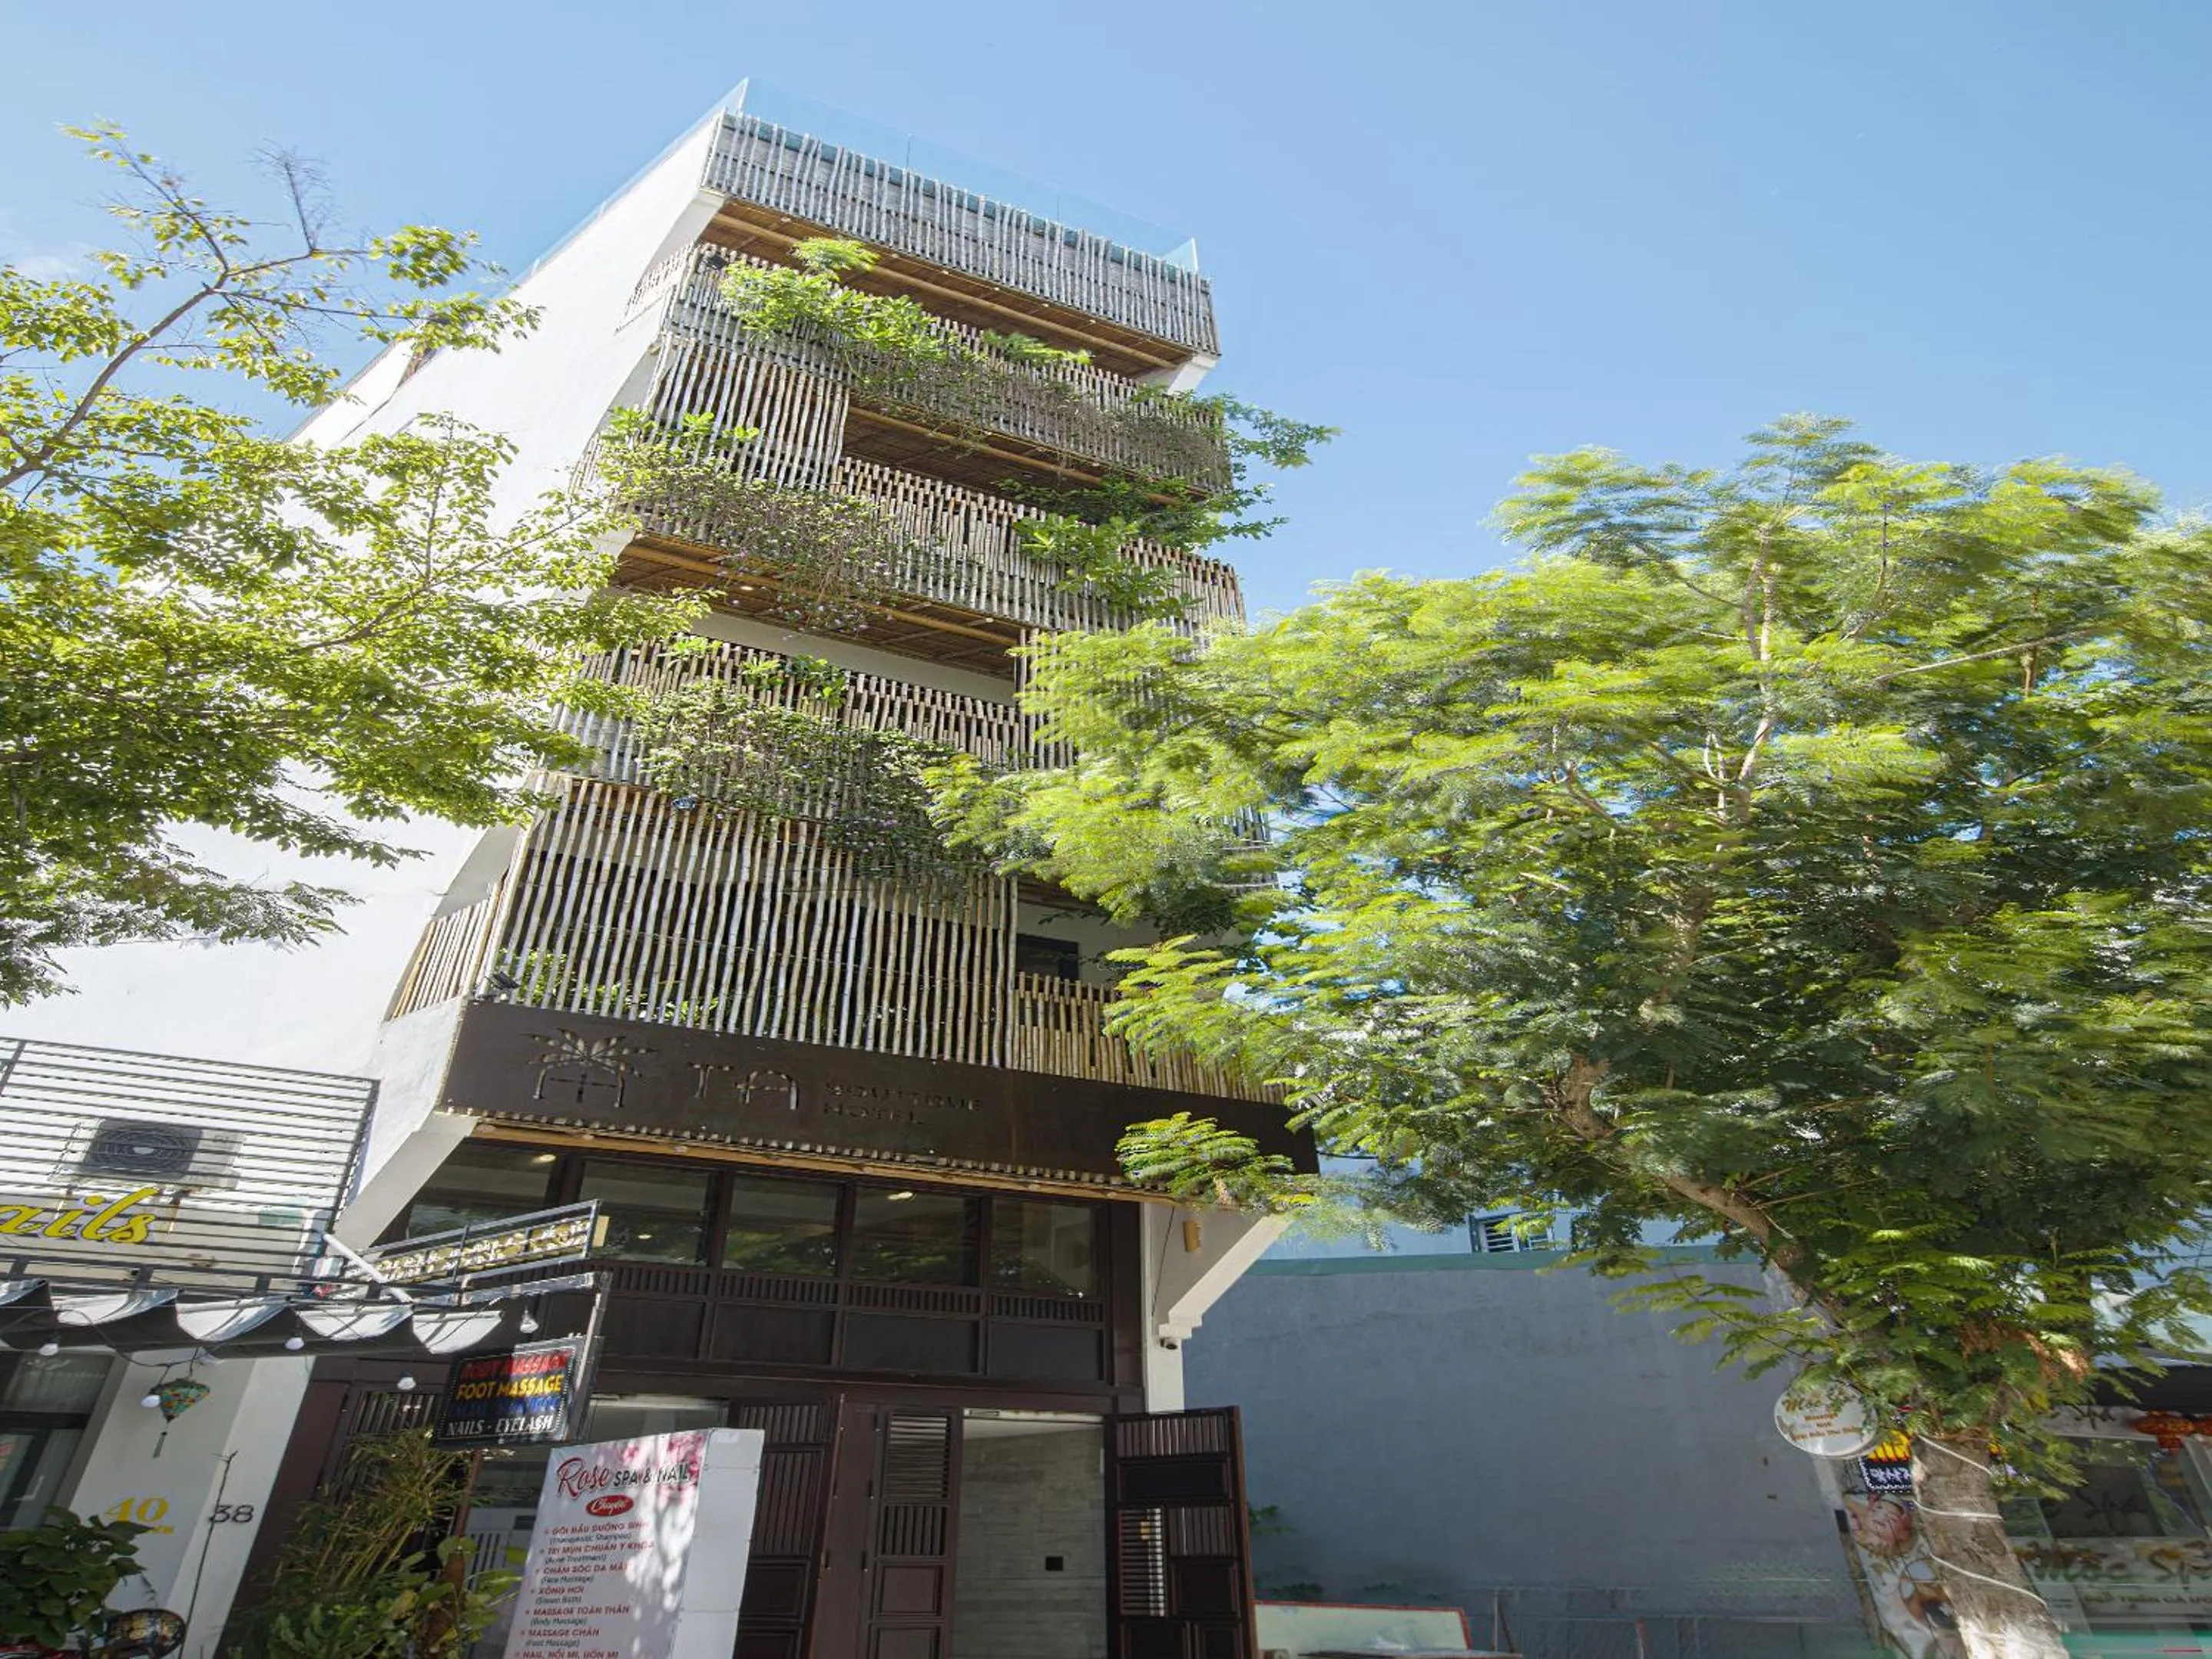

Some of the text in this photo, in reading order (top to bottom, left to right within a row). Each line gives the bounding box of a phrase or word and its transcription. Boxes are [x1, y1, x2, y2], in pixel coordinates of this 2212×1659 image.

[456, 1374, 565, 1400] FOOT MASSAGE
[446, 1420, 484, 1435] NAILS
[494, 1416, 554, 1433] EYELASH
[557, 1457, 610, 1498] Rose
[614, 1470, 637, 1488] SPA
[642, 1467, 652, 1484] &
[104, 1496, 169, 1522] 40
[208, 1505, 254, 1523] 38
